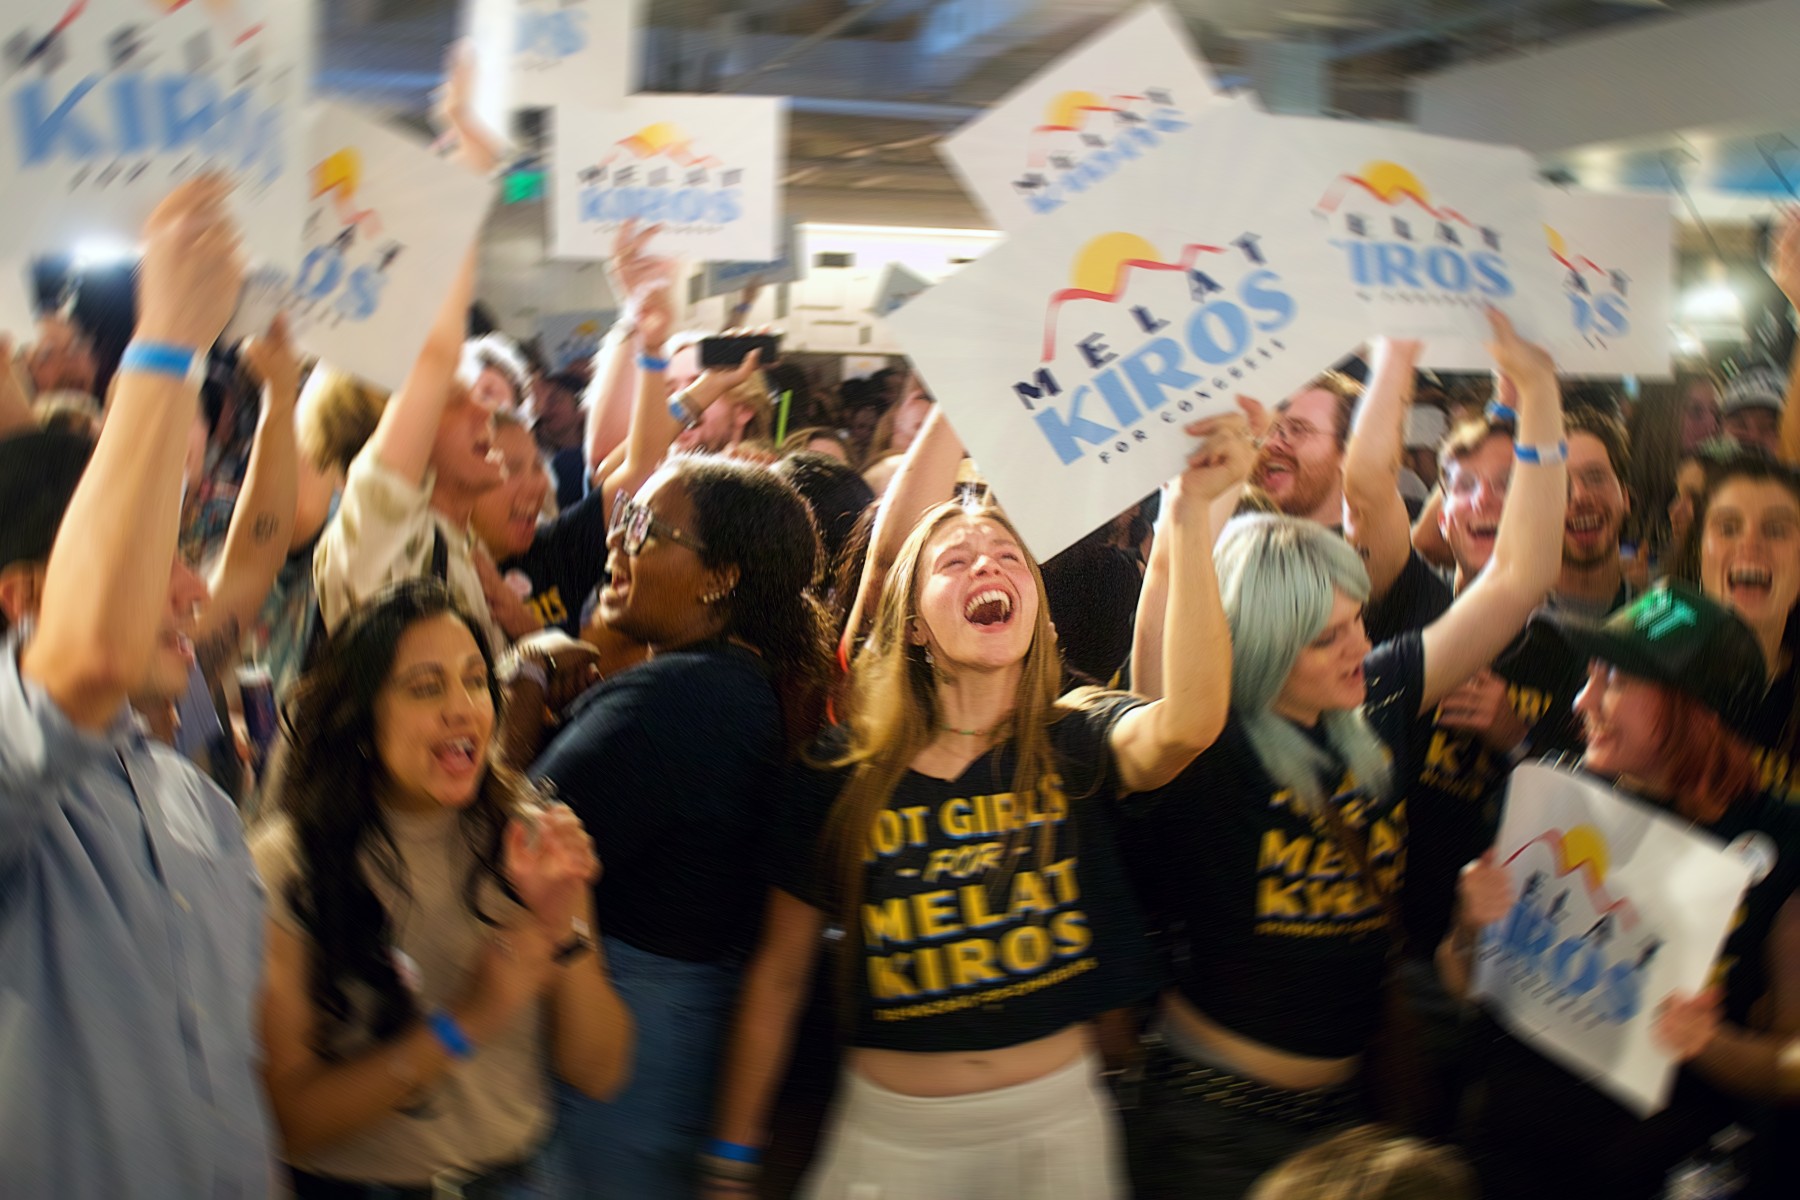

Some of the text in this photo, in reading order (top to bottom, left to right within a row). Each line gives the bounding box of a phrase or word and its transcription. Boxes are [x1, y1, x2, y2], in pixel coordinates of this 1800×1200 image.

[1310, 208, 1501, 252] ELAT
[1328, 237, 1517, 299] IROS
[1012, 230, 1268, 411] MELAT
[1031, 269, 1299, 467] KIROS
[1098, 336, 1287, 464] FOR CONGRESS
[863, 773, 1070, 862] OT GIRLS
[861, 857, 1080, 949] MELAT
[866, 910, 1094, 1001] KIROS
